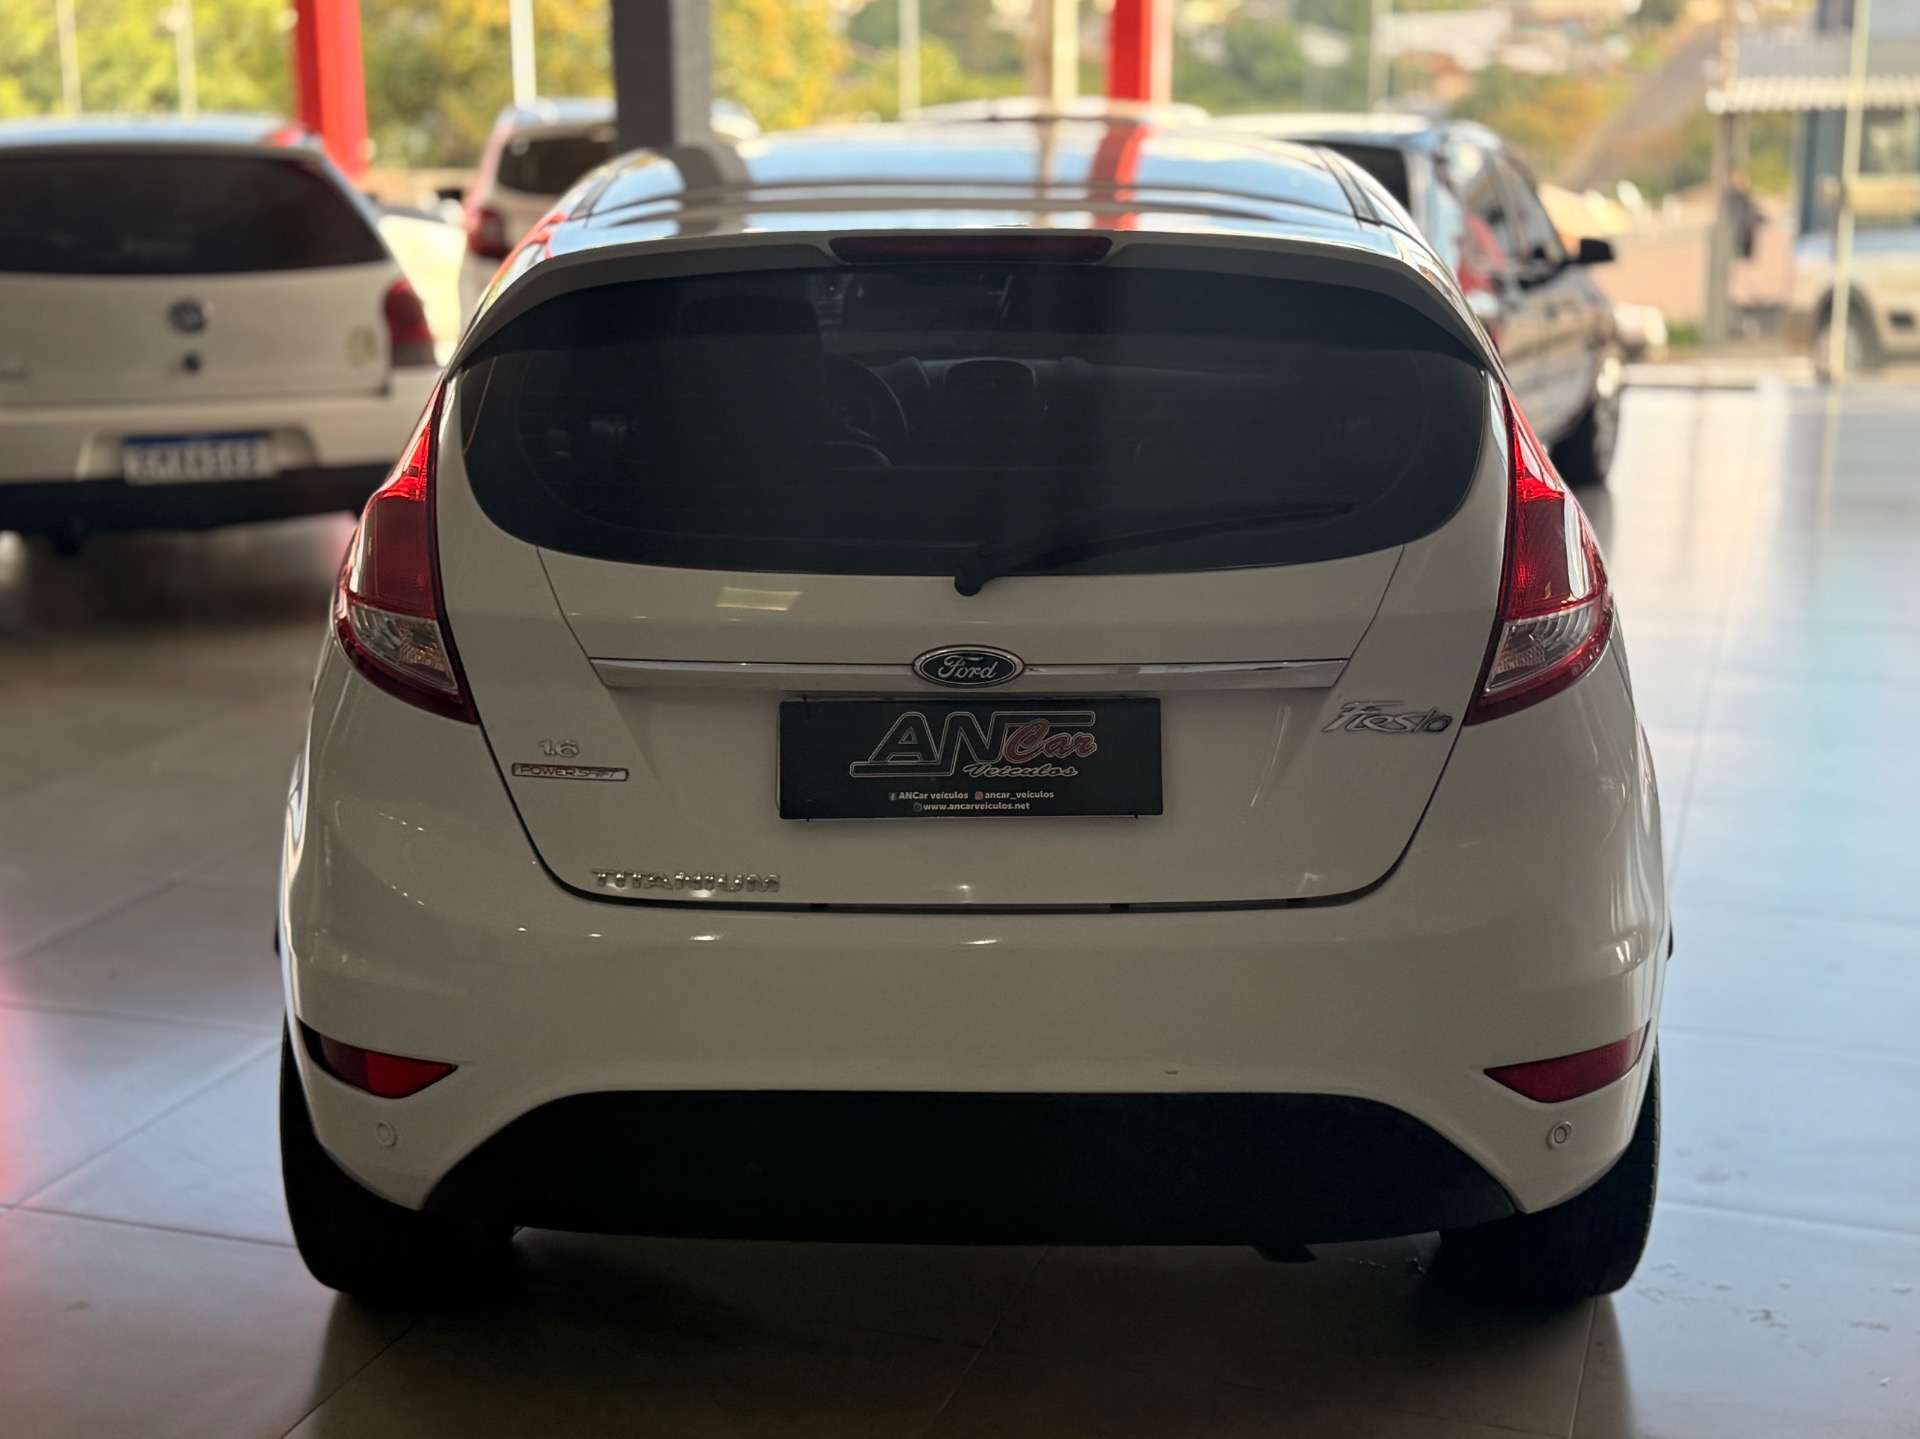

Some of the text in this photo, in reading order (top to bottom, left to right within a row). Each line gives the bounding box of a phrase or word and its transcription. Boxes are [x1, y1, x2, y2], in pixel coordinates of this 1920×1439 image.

[937, 654, 999, 679] Ford
[1004, 718, 1098, 763] Car
[899, 792, 929, 800] ANCar
[591, 869, 781, 893] TITANIUM
